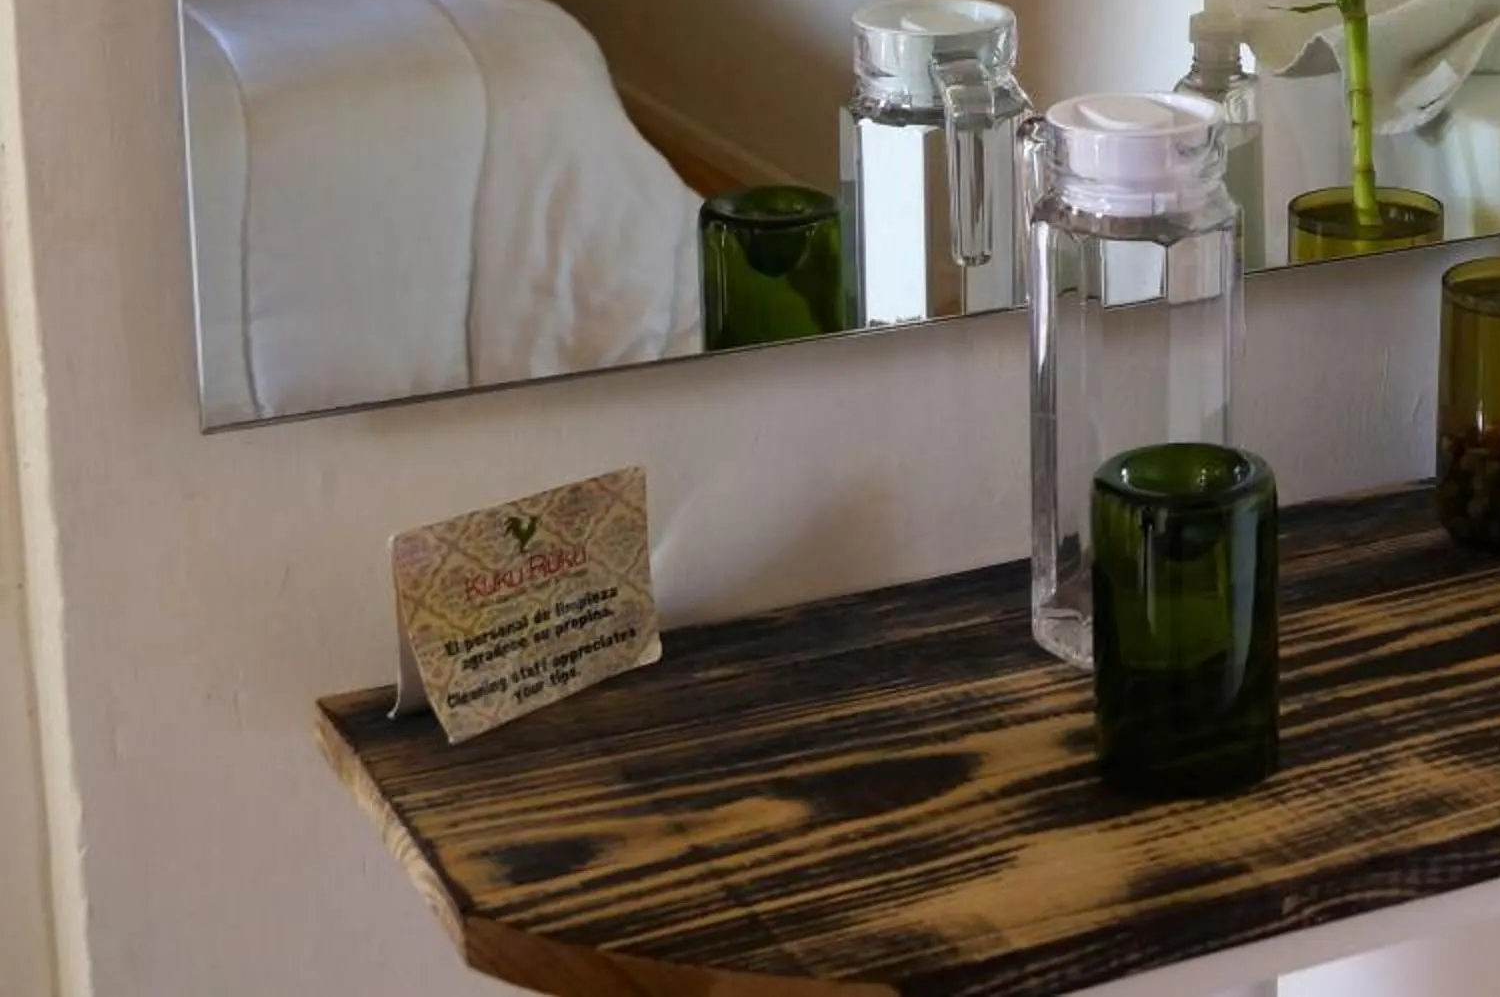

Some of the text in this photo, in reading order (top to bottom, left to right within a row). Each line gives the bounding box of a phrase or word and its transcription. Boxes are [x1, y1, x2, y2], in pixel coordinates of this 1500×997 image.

[463, 615, 529, 650] personal
[533, 609, 550, 624] de
[555, 587, 618, 617] limpieza
[447, 628, 637, 707] Cleaning staff appreciates
